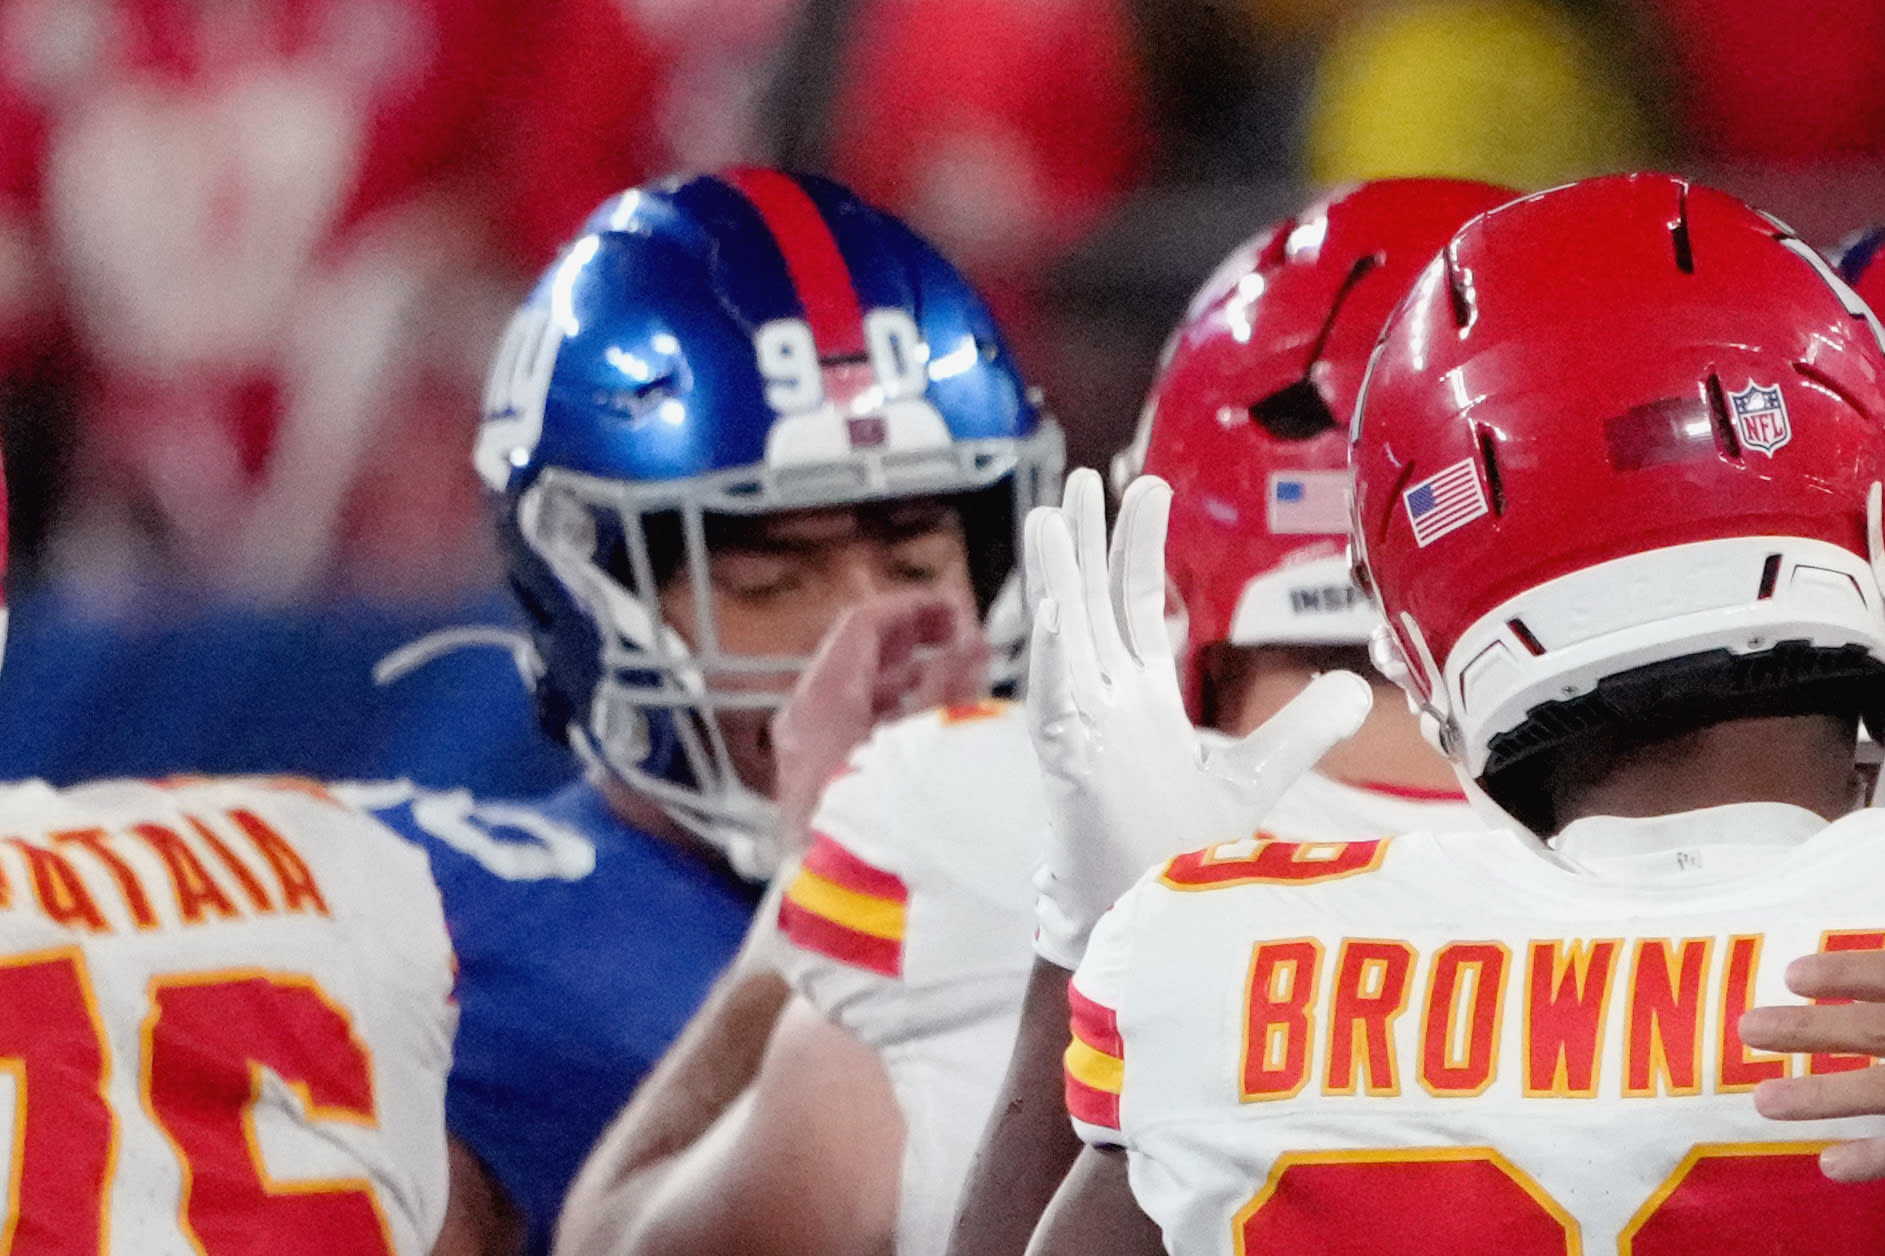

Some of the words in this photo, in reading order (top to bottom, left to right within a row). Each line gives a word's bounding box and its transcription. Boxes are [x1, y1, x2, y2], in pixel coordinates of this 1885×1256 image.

[755, 306, 931, 411] 90
[1742, 411, 1784, 443] NFL
[0, 806, 334, 935] ATAIA
